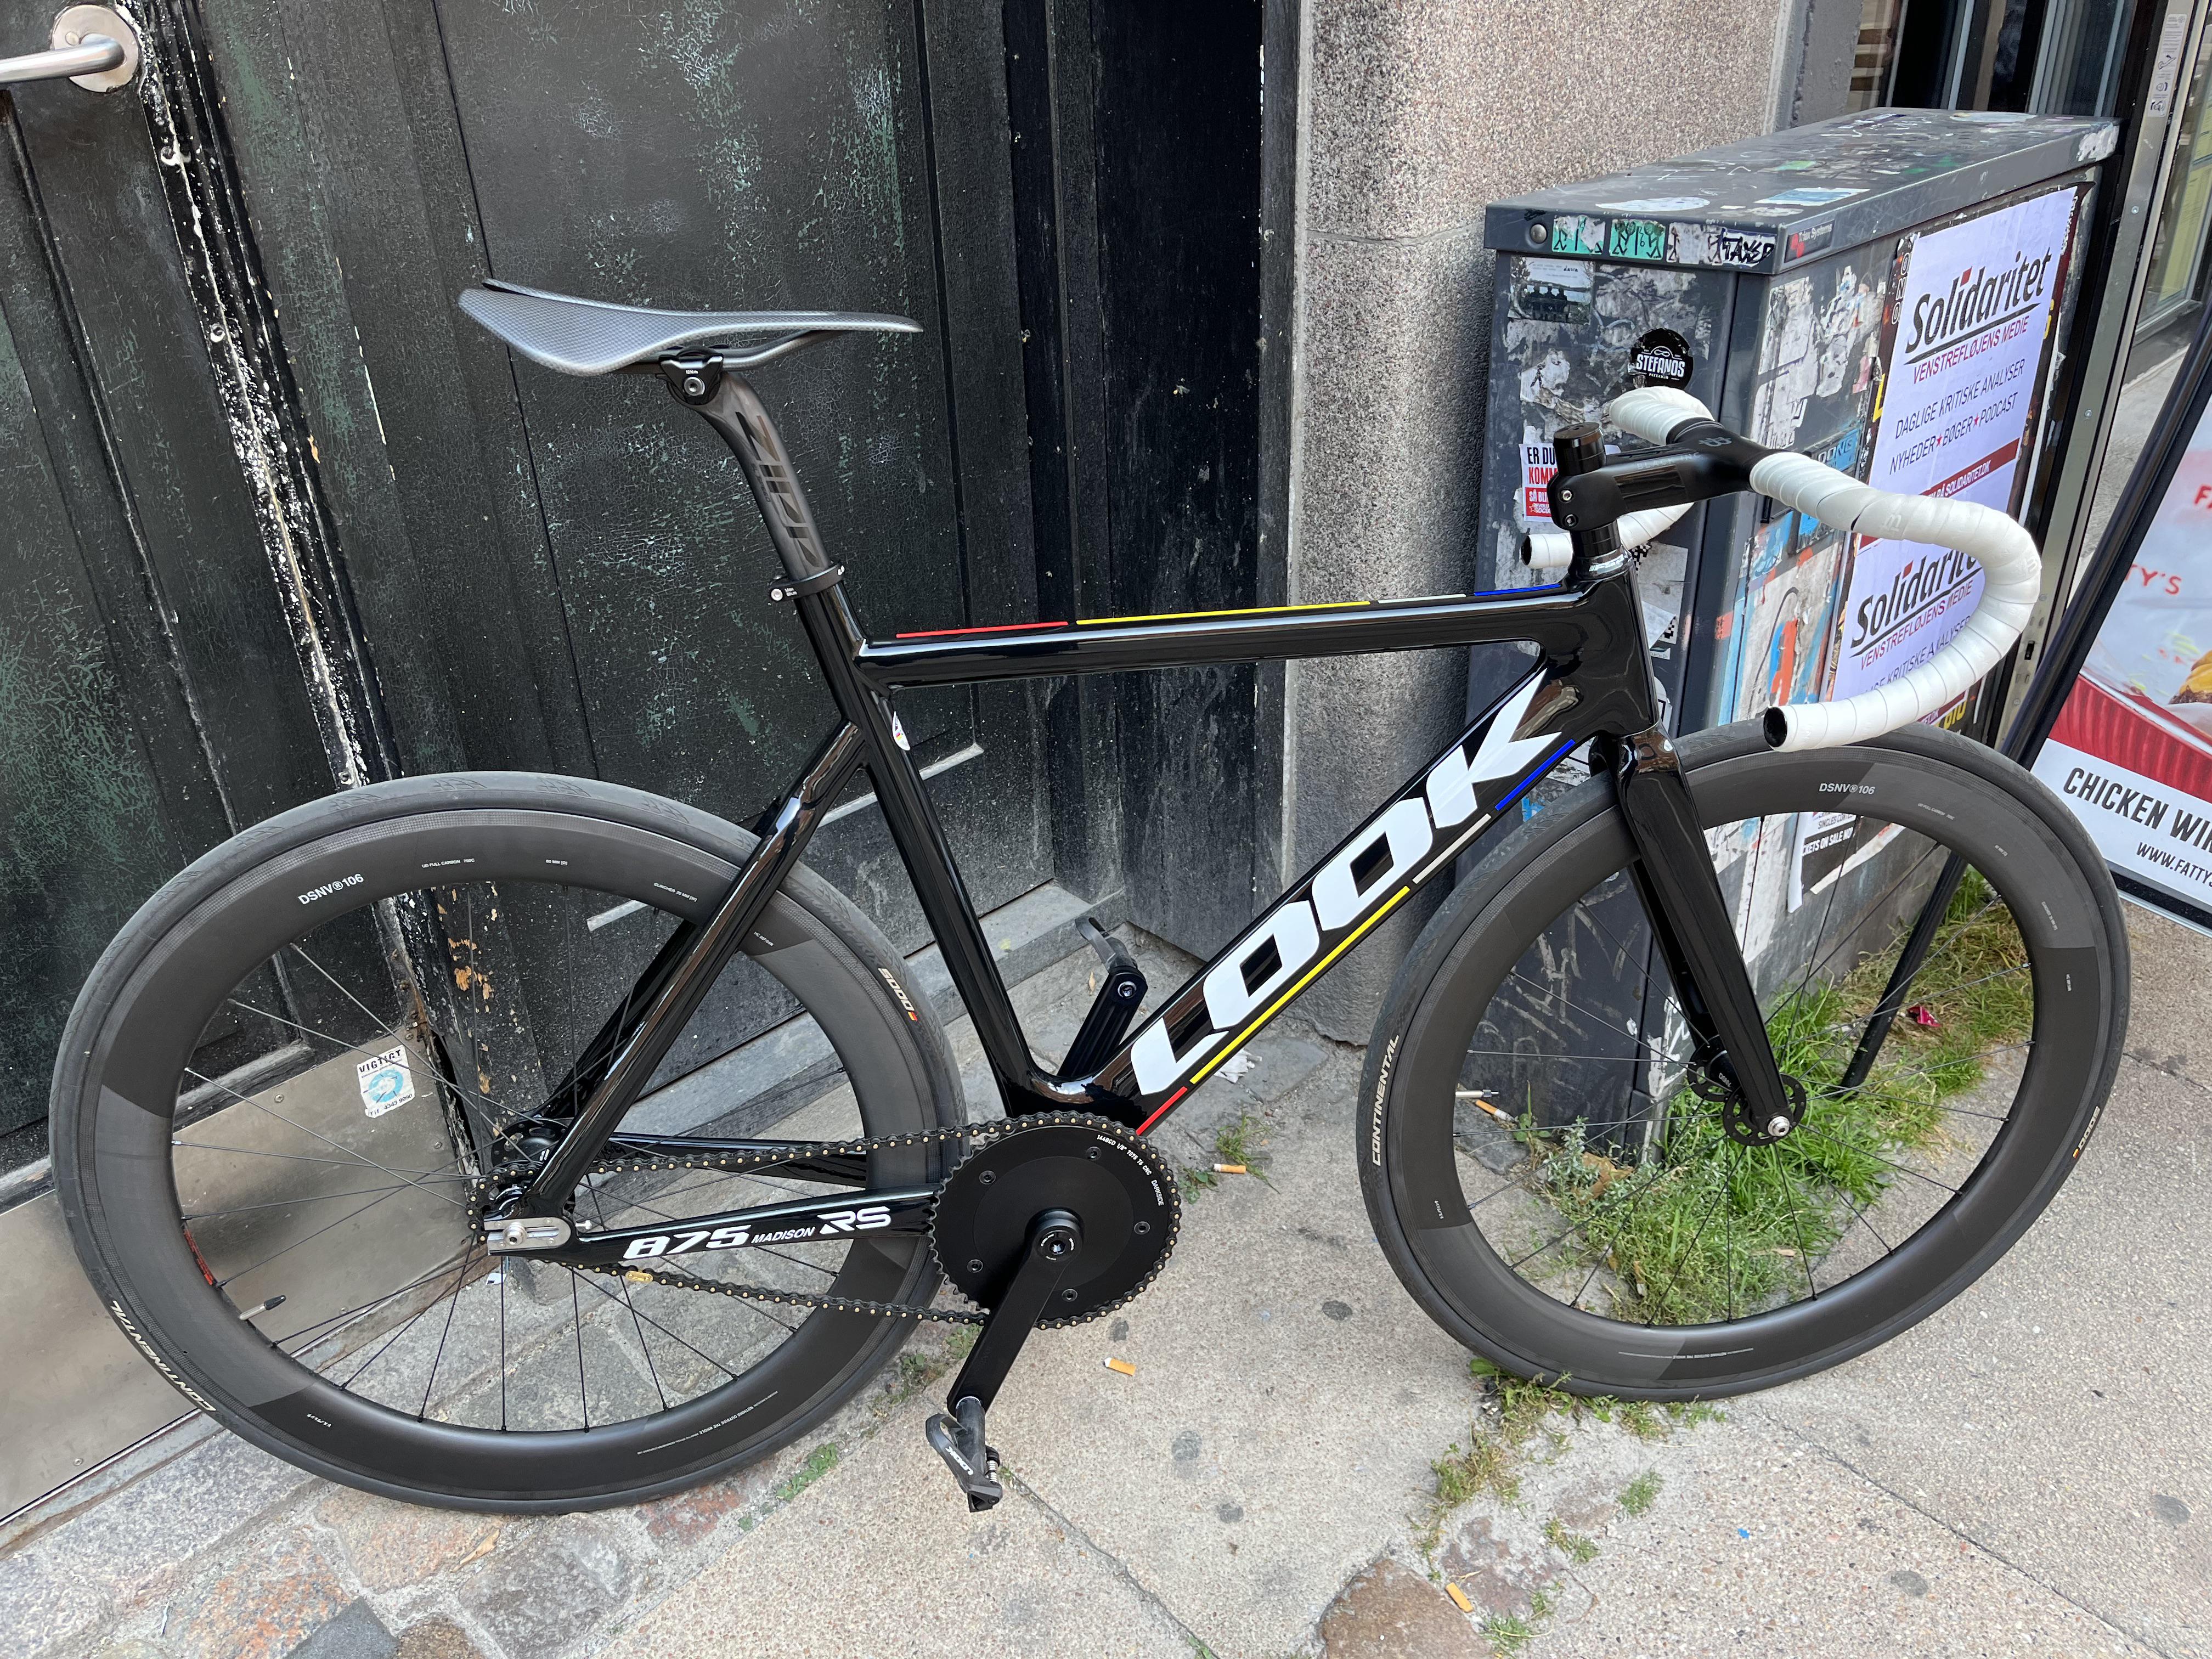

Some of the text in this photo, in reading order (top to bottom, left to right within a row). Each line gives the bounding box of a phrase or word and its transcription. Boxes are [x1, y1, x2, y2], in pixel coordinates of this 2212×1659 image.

[1905, 247, 2052, 353] Solidaritet
[1636, 354, 1685, 377] STEFANOS
[1914, 315, 2029, 385] VENSTREFLØJENS MEDIE
[1889, 392, 2018, 475] NYHEDER BØGER PODCAST
[1895, 358, 2025, 439] DAGLIGE KRITISKE ANALYSER
[1527, 447, 1555, 465] ER DU
[1861, 600, 1945, 670] VENSTREFLØJENS
[2063, 768, 2169, 830] CHICKEN
[1829, 831, 1843, 846] SALE
[1130, 668, 1562, 1096] LOOK
[1373, 1035, 1399, 1166] CONTINENTAL
[1142, 1165, 1152, 1176] CNC
[1151, 1180, 1164, 1206] DARKSIDE
[623, 1206, 891, 1259] 875 MADISON RS
[110, 1300, 216, 1410] CONTINENTAL
